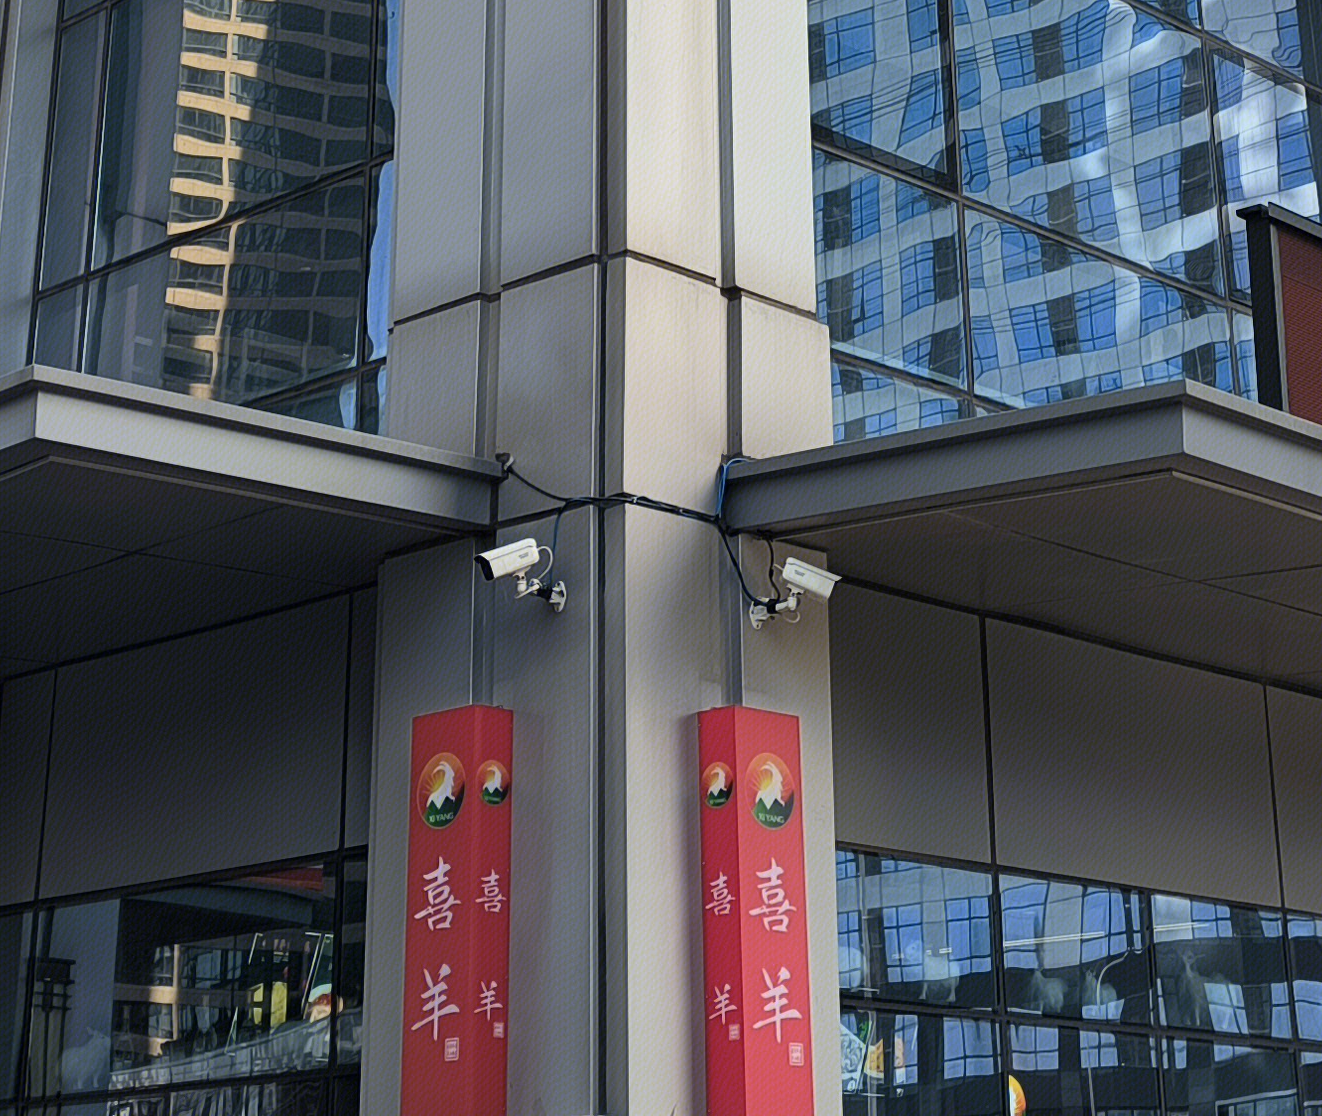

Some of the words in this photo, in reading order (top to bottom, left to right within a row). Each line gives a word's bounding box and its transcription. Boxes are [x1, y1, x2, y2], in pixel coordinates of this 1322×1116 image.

[411, 856, 462, 1042] 喜羊
[473, 868, 507, 1022] 喜羊
[705, 872, 738, 1025] 喜羊
[748, 856, 803, 1044] 喜羊
